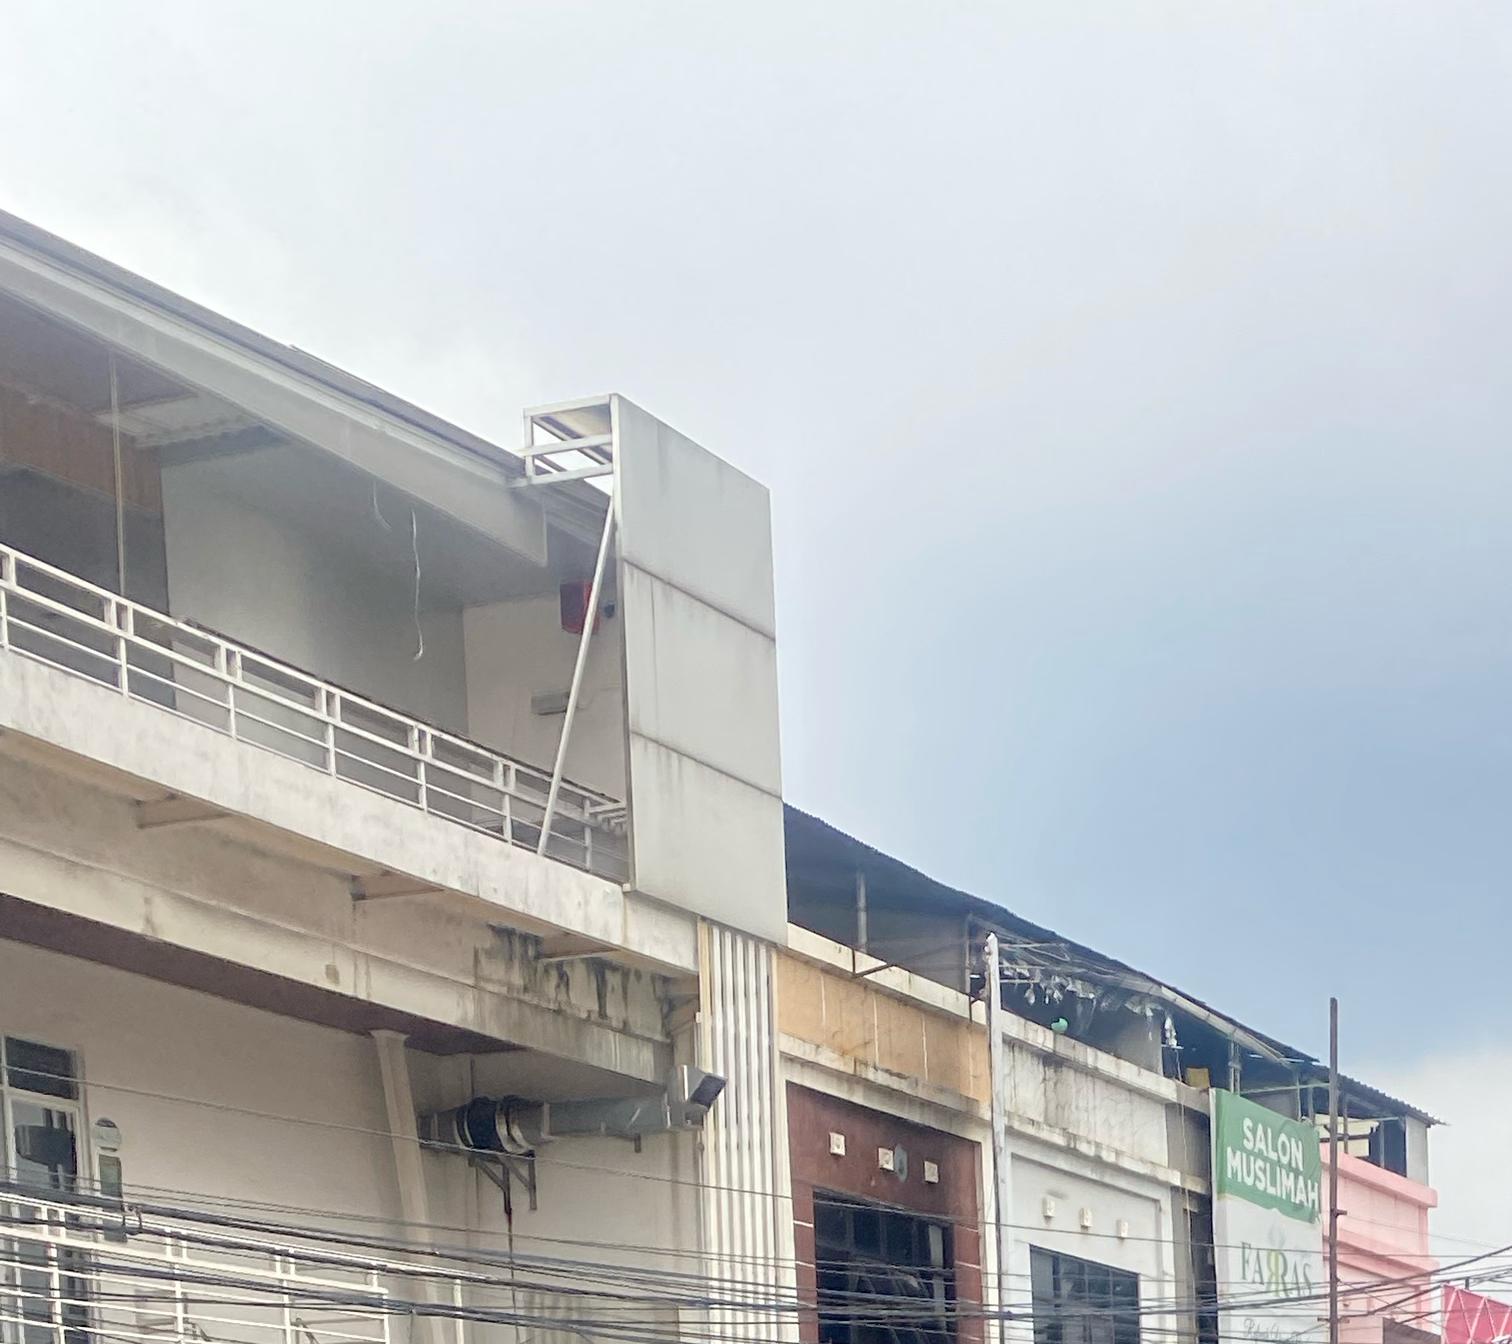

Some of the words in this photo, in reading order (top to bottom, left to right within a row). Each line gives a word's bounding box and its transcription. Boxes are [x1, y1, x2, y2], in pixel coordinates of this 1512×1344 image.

[1242, 1117, 1304, 1172] SALON
[1226, 1148, 1320, 1210] MUSLIMAH
[1240, 1240, 1314, 1299] FARRAS
